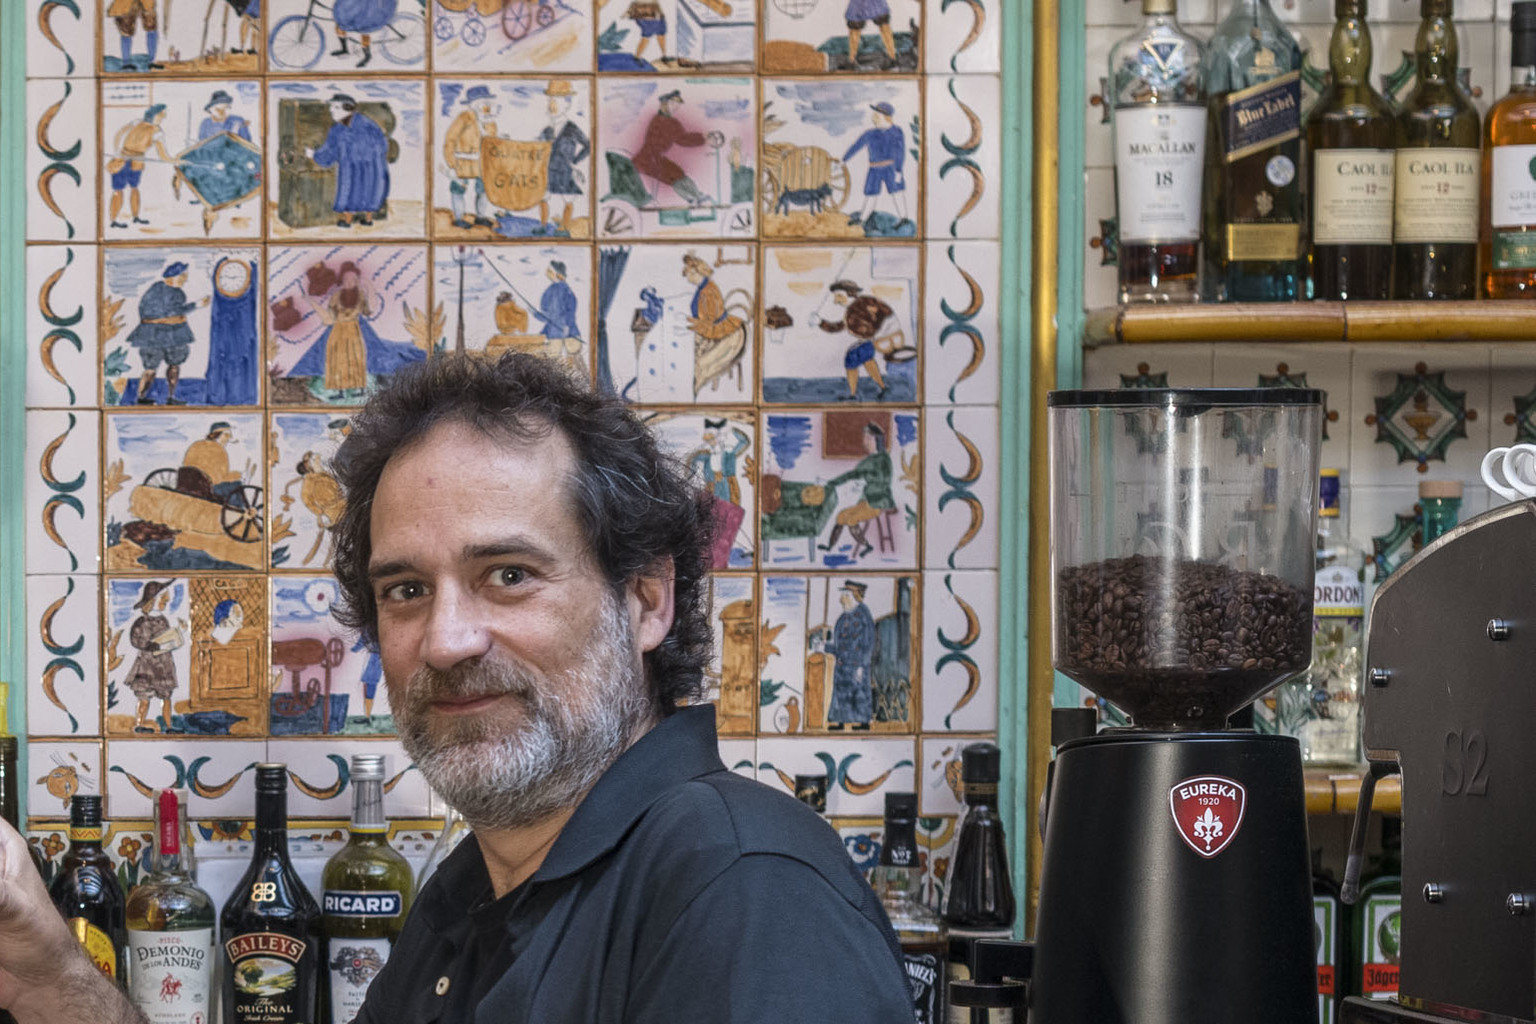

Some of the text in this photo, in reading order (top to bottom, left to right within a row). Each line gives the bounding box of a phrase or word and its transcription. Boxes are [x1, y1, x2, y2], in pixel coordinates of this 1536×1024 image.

[1265, 93, 1297, 116] Label
[1129, 142, 1196, 155] MACALLAN
[1155, 170, 1173, 187] 18
[1365, 182, 1378, 195] 12
[1436, 181, 1450, 195] 12
[1179, 783, 1237, 801] EUREKA
[1198, 797, 1220, 806] 1920
[325, 895, 395, 912] RICARD
[136, 944, 205, 962] DEMONIO
[230, 936, 300, 957] BAILEYS
[162, 956, 203, 971] ANDES
[236, 1005, 294, 1014] ORIGINAL
